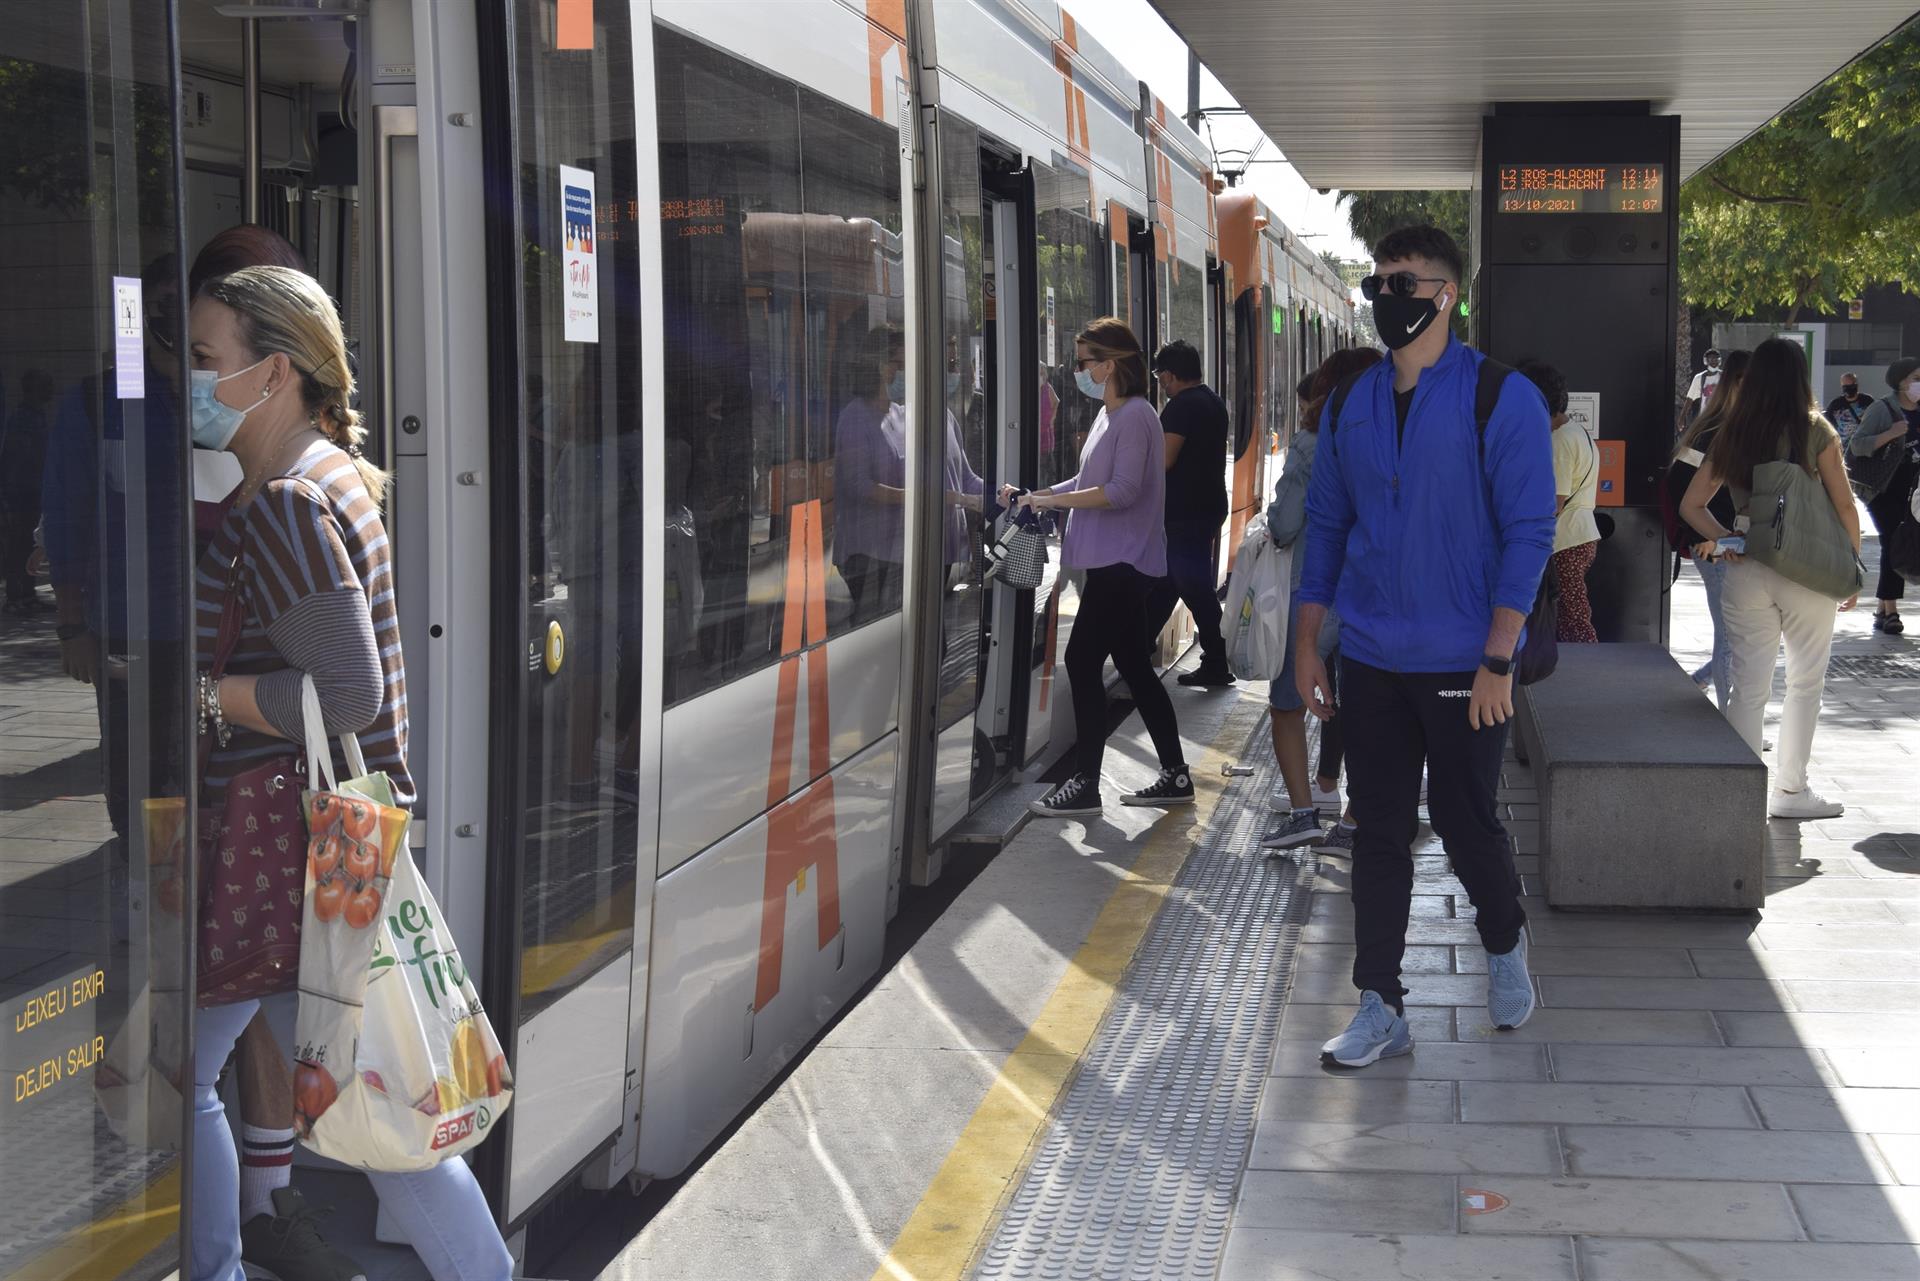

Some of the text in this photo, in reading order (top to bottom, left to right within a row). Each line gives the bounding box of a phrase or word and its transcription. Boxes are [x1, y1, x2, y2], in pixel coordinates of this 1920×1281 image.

[1501, 169, 1517, 180] L2
[1622, 168, 1656, 179] 12:11
[1501, 179, 1517, 190] L2
[1622, 179, 1658, 190] 12:27
[1504, 199, 1658, 211] 13/10/2021 12:07
[72, 970, 105, 1008] EIXIR
[15, 1035, 105, 1103] DEJEN SALIR
